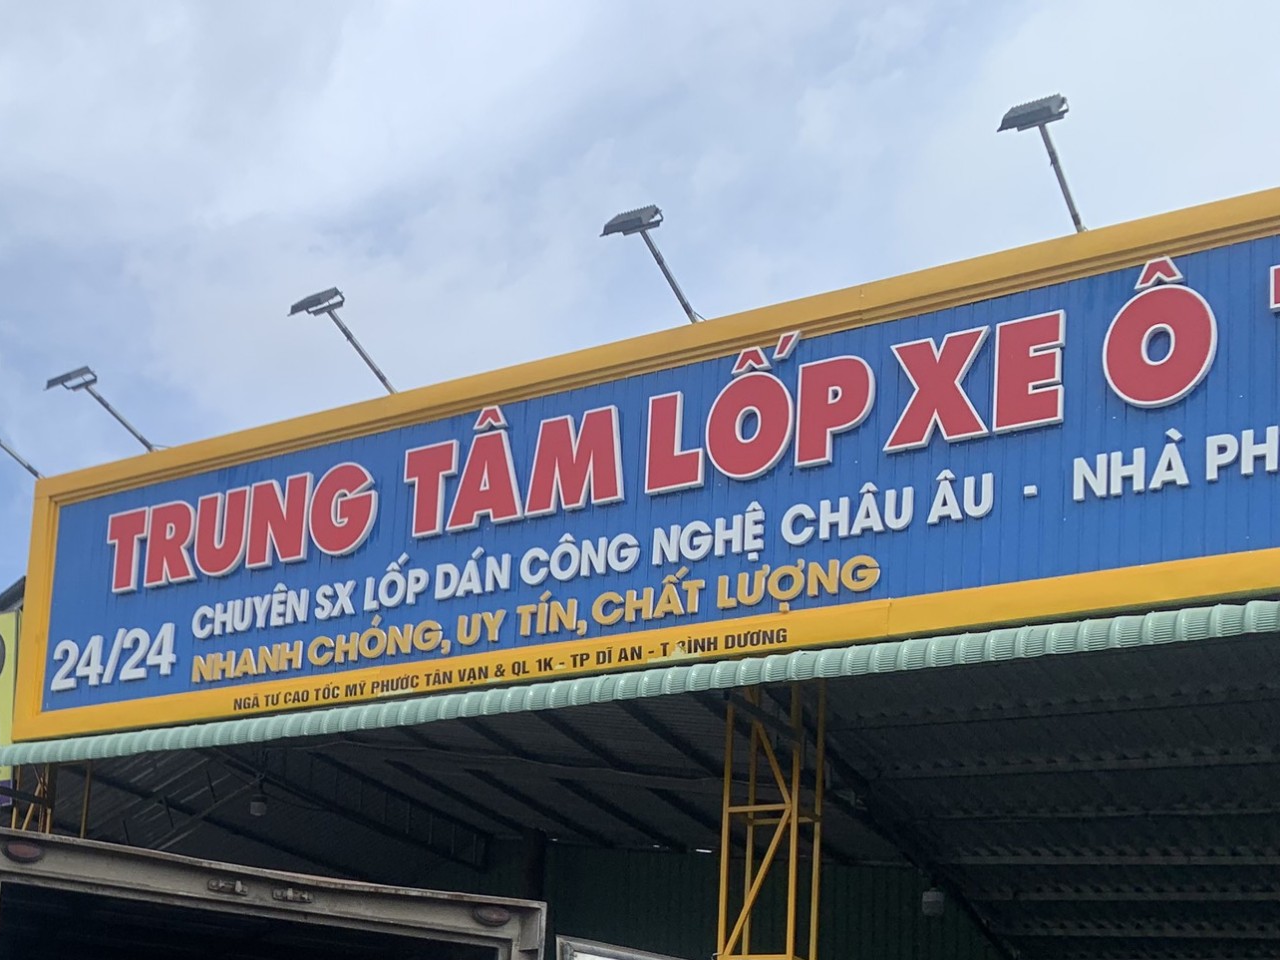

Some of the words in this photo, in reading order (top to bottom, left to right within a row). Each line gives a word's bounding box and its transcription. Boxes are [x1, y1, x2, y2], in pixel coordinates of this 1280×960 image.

[107, 462, 378, 593] TRUNG
[403, 405, 624, 538] TÂM
[645, 330, 876, 494] LỐP
[883, 309, 1066, 455] XE
[1102, 256, 1218, 409] Ô
[192, 583, 309, 640] CHUYÊN
[314, 580, 356, 621] SX
[363, 552, 430, 611] LỐP
[434, 546, 511, 601] DÁN
[520, 533, 640, 587] CÔNG
[652, 501, 765, 562] NGHỆ
[780, 482, 914, 546] CHÂU
[926, 469, 995, 525] ÂU
[1073, 428, 1190, 501] NHÀ
[50, 622, 176, 692] 24/24
[192, 641, 303, 683] NHANH
[308, 615, 451, 667] CHÓNG,
[456, 608, 506, 647] UY
[517, 590, 588, 638] TÍN,
[591, 565, 706, 627] CHẤT
[717, 554, 881, 612] LƯỢNG
[233, 693, 259, 711] NGÃ
[264, 691, 282, 707] TƯ
[283, 690, 309, 704] CAO
[314, 681, 339, 701] TỐC
[345, 681, 367, 697] MỸ
[371, 674, 420, 694] PHƯỚC
[424, 669, 453, 686] TÂN
[458, 666, 489, 684] VẠN
[494, 664, 506, 678] &
[511, 660, 530, 676] QL
[536, 657, 553, 672] 1K
[570, 652, 590, 668] TP
[596, 646, 613, 665] DĨ
[620, 645, 642, 662] AN
[724, 628, 787, 650] DƯƠNG
